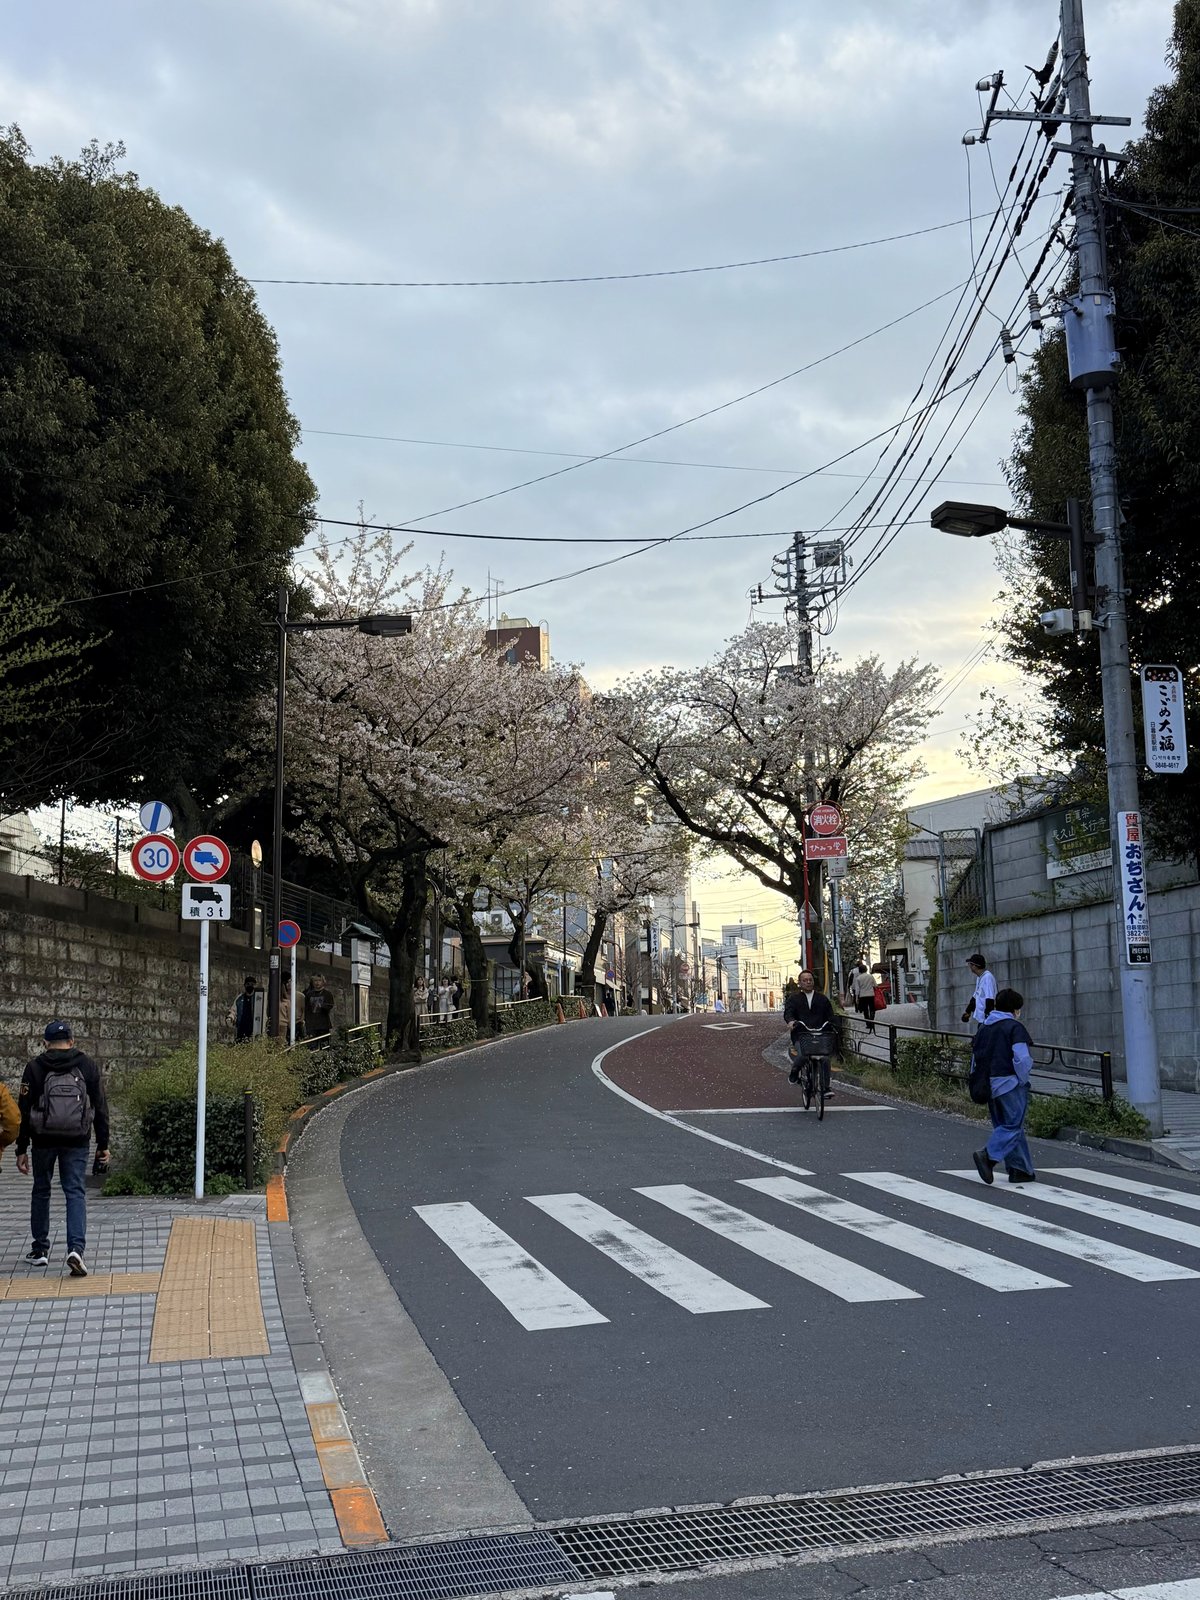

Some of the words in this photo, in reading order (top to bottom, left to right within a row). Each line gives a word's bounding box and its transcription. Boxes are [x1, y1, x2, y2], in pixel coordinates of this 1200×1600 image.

[813, 814, 838, 826] 消火栓
[809, 841, 841, 853] ひみつ堂
[143, 848, 169, 868] 30
[1125, 843, 1146, 912] おぢさん
[190, 907, 200, 917] 積
[206, 907, 214, 917] 3
